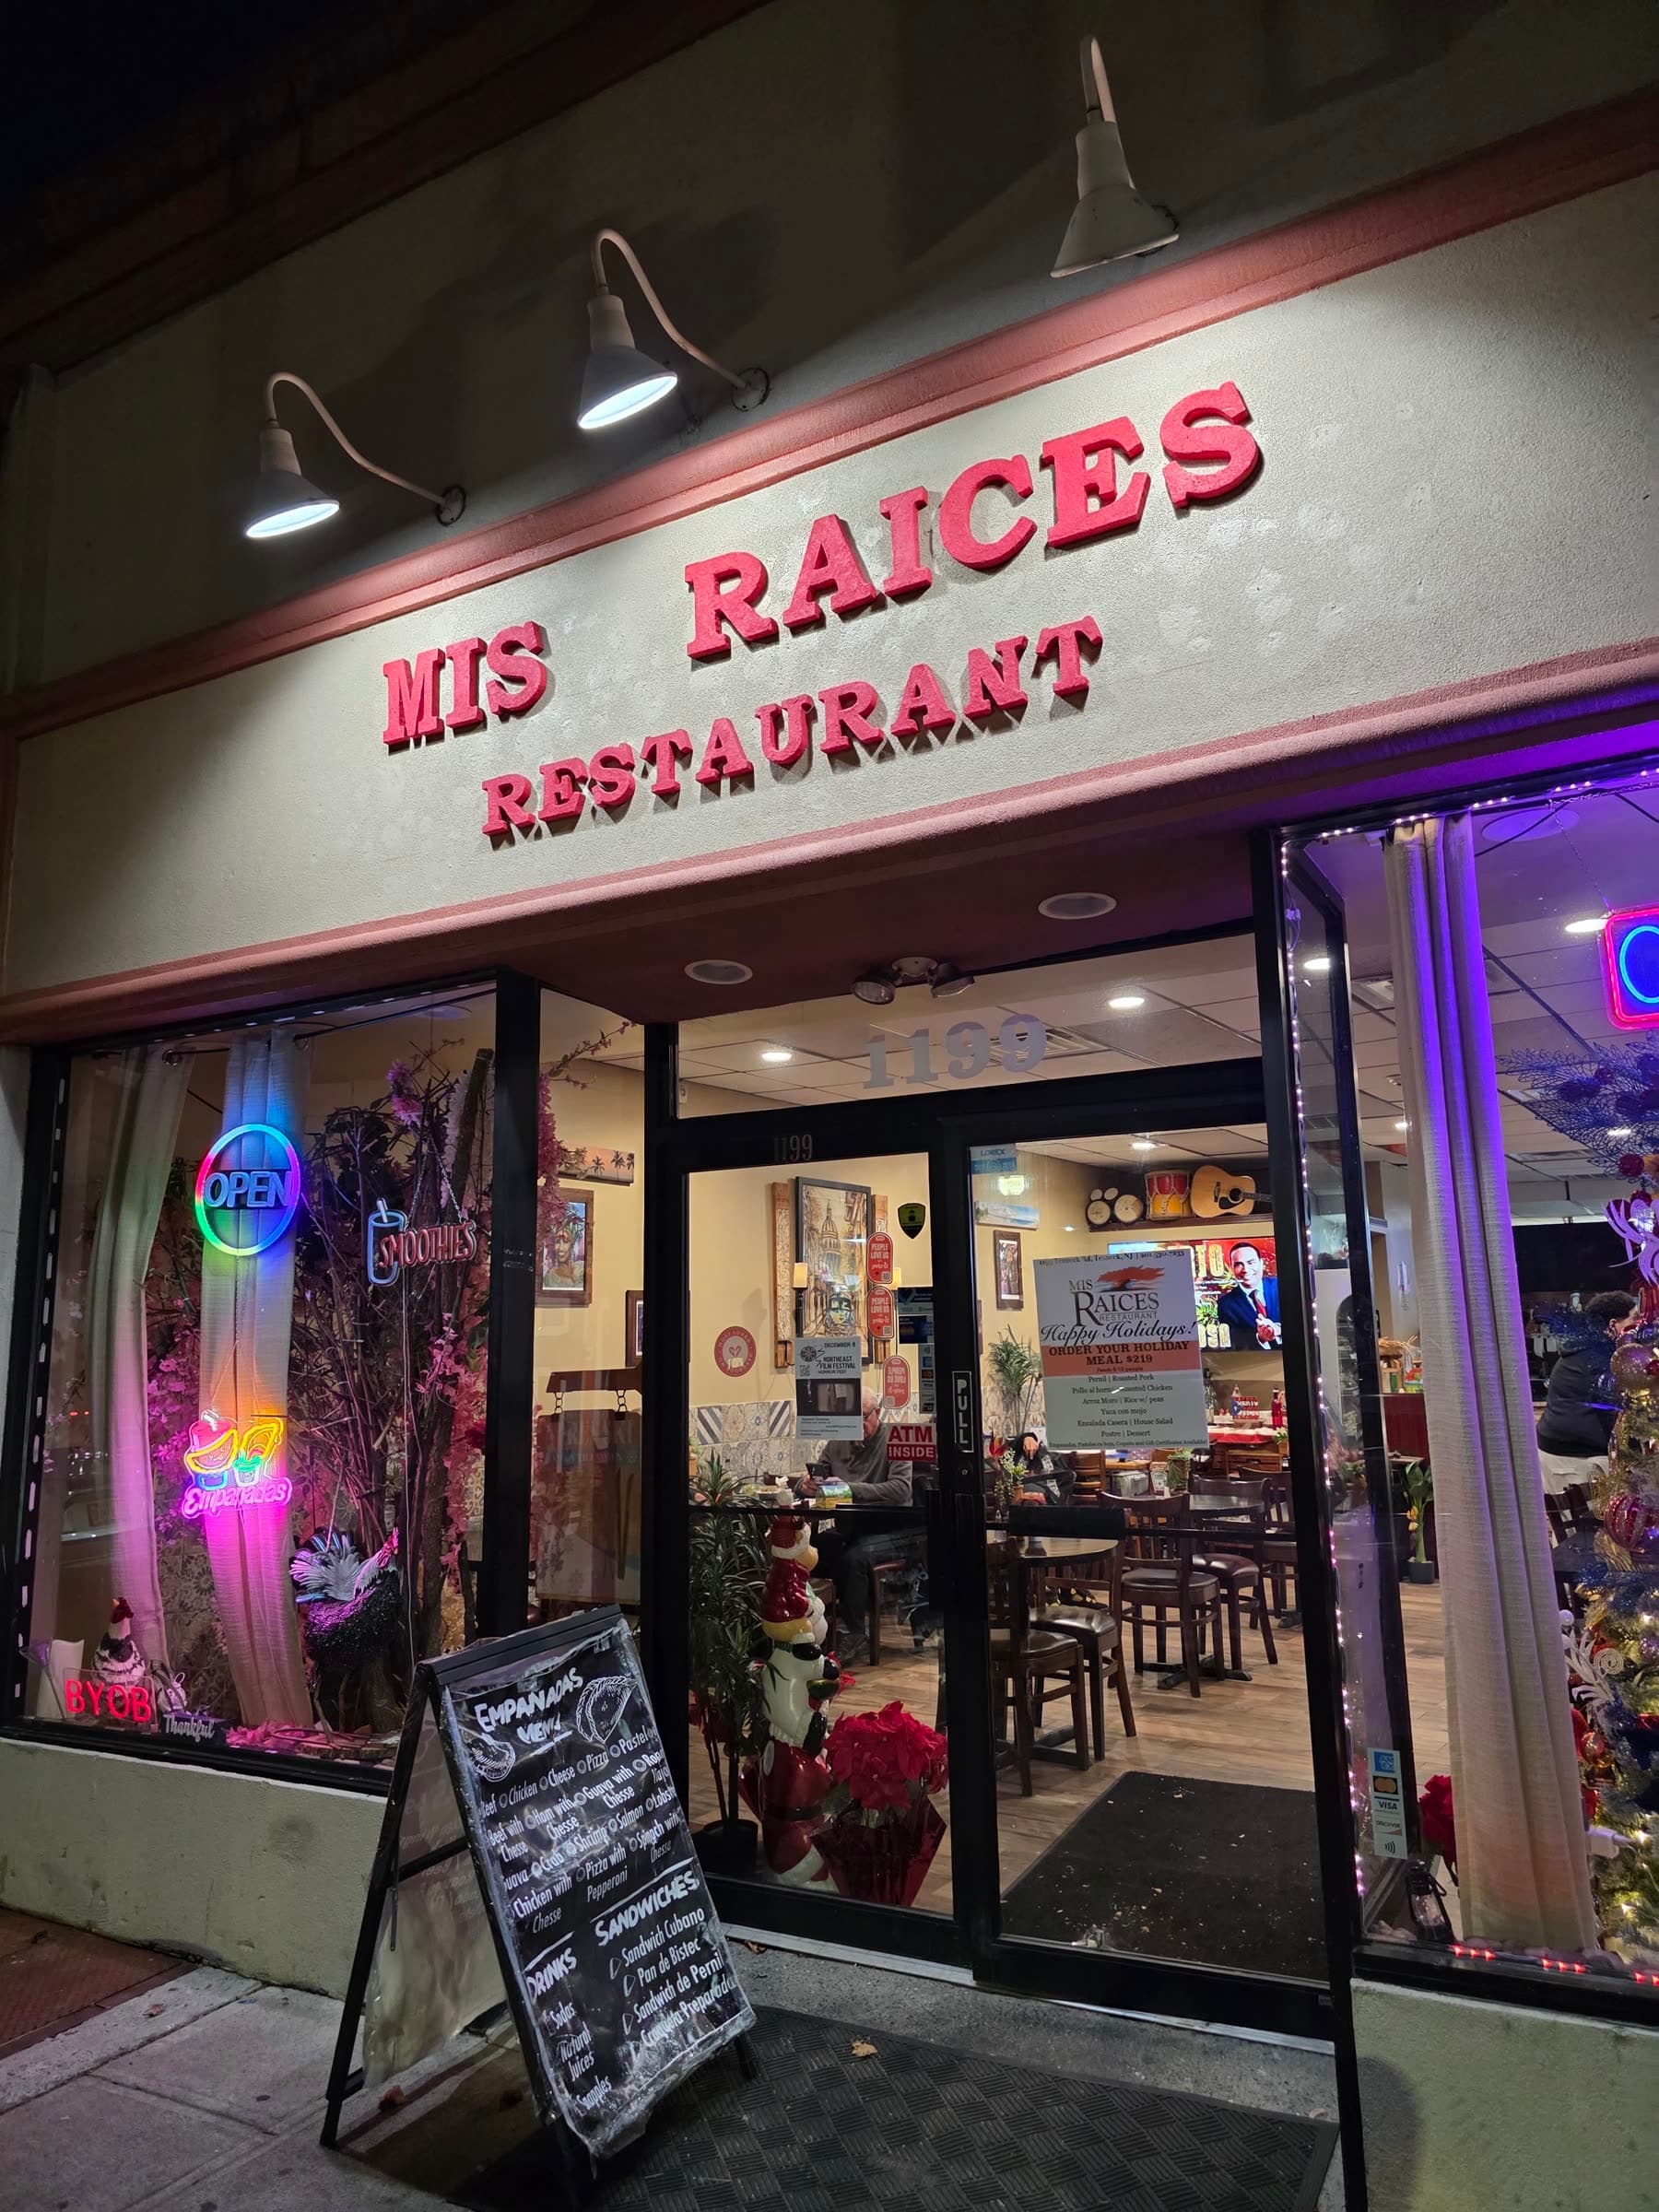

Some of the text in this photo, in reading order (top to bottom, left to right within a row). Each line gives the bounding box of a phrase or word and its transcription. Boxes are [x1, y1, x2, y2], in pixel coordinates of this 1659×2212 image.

[382, 380, 1261, 747] MIS RAICES
[481, 615, 1105, 839] RESTAURANT
[863, 1014, 1047, 1089] 1199
[204, 1171, 295, 1207] OPEN
[379, 1220, 474, 1269] SMOOTHIES
[1069, 1279, 1093, 1290] MIS
[1071, 1291, 1159, 1326] RAICES
[1099, 1312, 1158, 1322] RESTAURANT
[1041, 1320, 1196, 1347] Happy Holidays!
[1049, 1341, 1190, 1357] ORDER YOUR HOLIDAY
[1086, 1355, 1124, 1366] MEAL
[957, 1379, 969, 1444] PULL
[1131, 1407, 1147, 1416] mojo
[1155, 1417, 1173, 1425] Salad
[888, 1426, 933, 1442] ATM
[888, 1447, 935, 1457] INSIDE
[184, 1481, 288, 1514] Empanadas
[65, 1679, 151, 1723] BYOB
[474, 1667, 583, 1733] EMPANADAS
[162, 1712, 216, 1743] Thankful
[509, 1781, 537, 1806] Chicken
[547, 1768, 575, 1787] Cheese
[586, 1751, 609, 1771] Pizza
[488, 1822, 508, 1846] Beef
[506, 1815, 524, 1837] with
[532, 1807, 555, 1826] Ham
[553, 1794, 575, 1815] with
[582, 1779, 615, 1800] Guava
[612, 1765, 635, 1784] with
[500, 1841, 528, 1863] Chesse
[547, 1816, 580, 1842] Chesse
[603, 1785, 635, 1808] Chesse
[1379, 1801, 1398, 1810] VISA
[504, 1869, 529, 1892] uava
[539, 1851, 565, 1872] Crab
[573, 1824, 609, 1853] Shrimp
[616, 1805, 644, 1830] Salmon
[512, 1887, 553, 1918] Chicken
[553, 1872, 572, 1897] with
[585, 1856, 608, 1880] Pizza
[609, 1842, 627, 1866] with
[533, 1841, 671, 1934] Chesse Pepperoni Chesse
[594, 1870, 700, 1947] SANDWICHES
[622, 1908, 705, 1968] Sandwich Cubano
[526, 1947, 577, 2004] DRINKS
[637, 1937, 700, 1987] Pan de Bistec
[633, 1948, 724, 2023] Sandwich de Pernil
[679, 1973, 737, 2018] Preparada
[549, 2001, 576, 2030] Sodas
[560, 2020, 592, 2063] Natural
[568, 2050, 595, 2082] Juices
